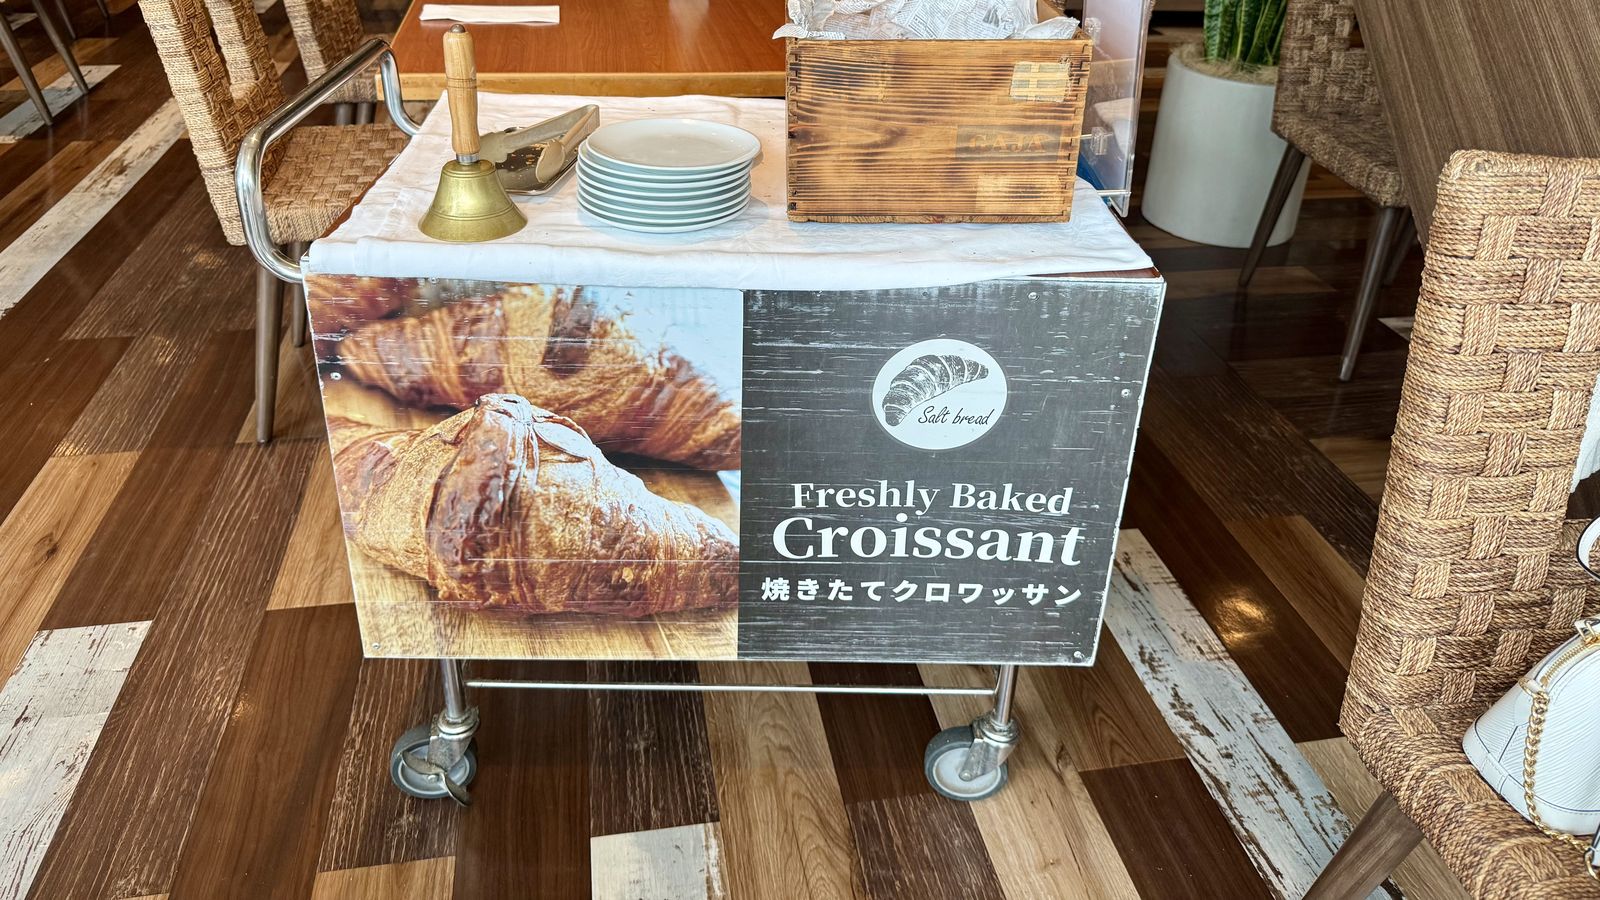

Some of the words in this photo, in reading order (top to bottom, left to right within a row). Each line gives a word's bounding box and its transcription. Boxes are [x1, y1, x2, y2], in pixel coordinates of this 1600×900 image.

[918, 406, 949, 425] Salt
[951, 406, 994, 425] bread
[791, 480, 940, 515] Freshly
[949, 482, 1074, 515] Baked
[772, 513, 1086, 566] Croissant
[760, 577, 1082, 607] 焼きたてクロワッサン
